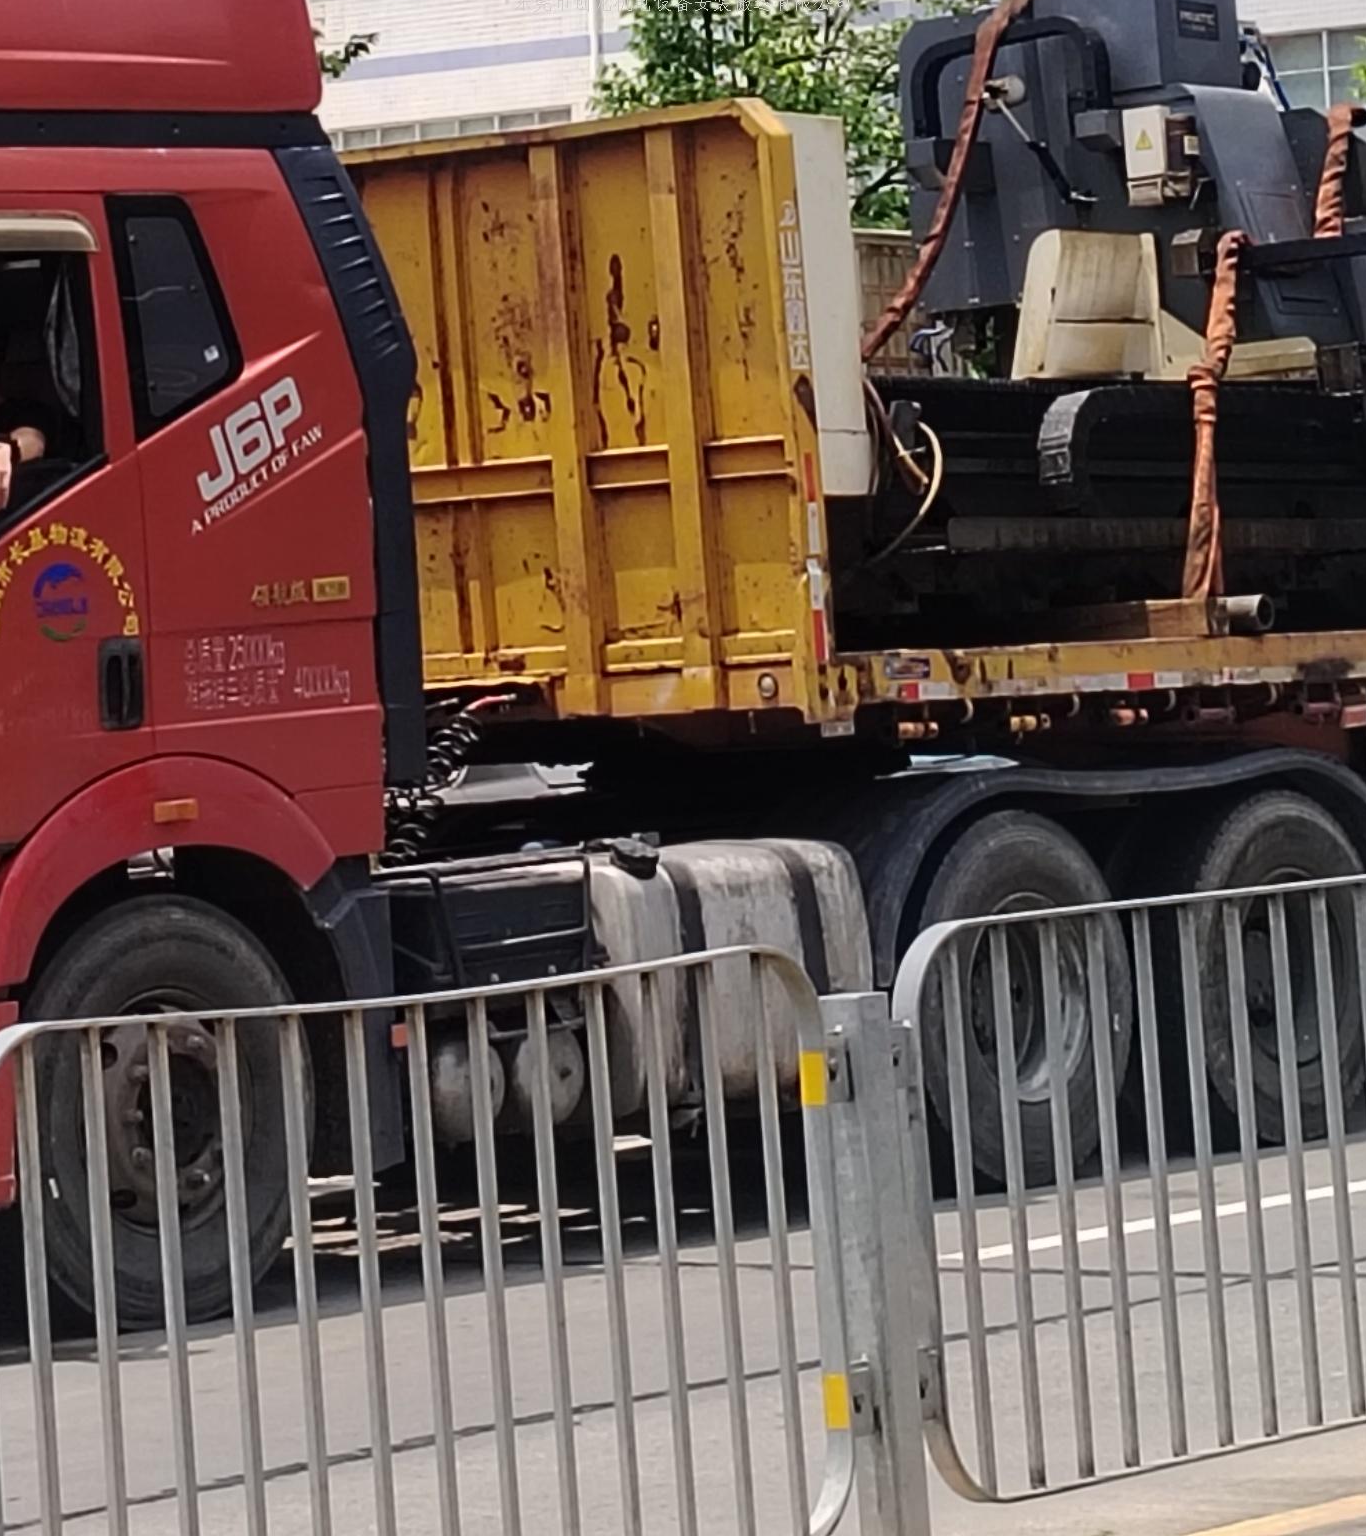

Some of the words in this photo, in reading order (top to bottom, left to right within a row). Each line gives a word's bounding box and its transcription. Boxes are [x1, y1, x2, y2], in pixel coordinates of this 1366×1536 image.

[191, 518, 204, 537] A
[203, 464, 269, 526] PRODUCT
[270, 449, 290, 474] OF
[291, 423, 323, 457] FAW
[196, 376, 303, 502] J6P
